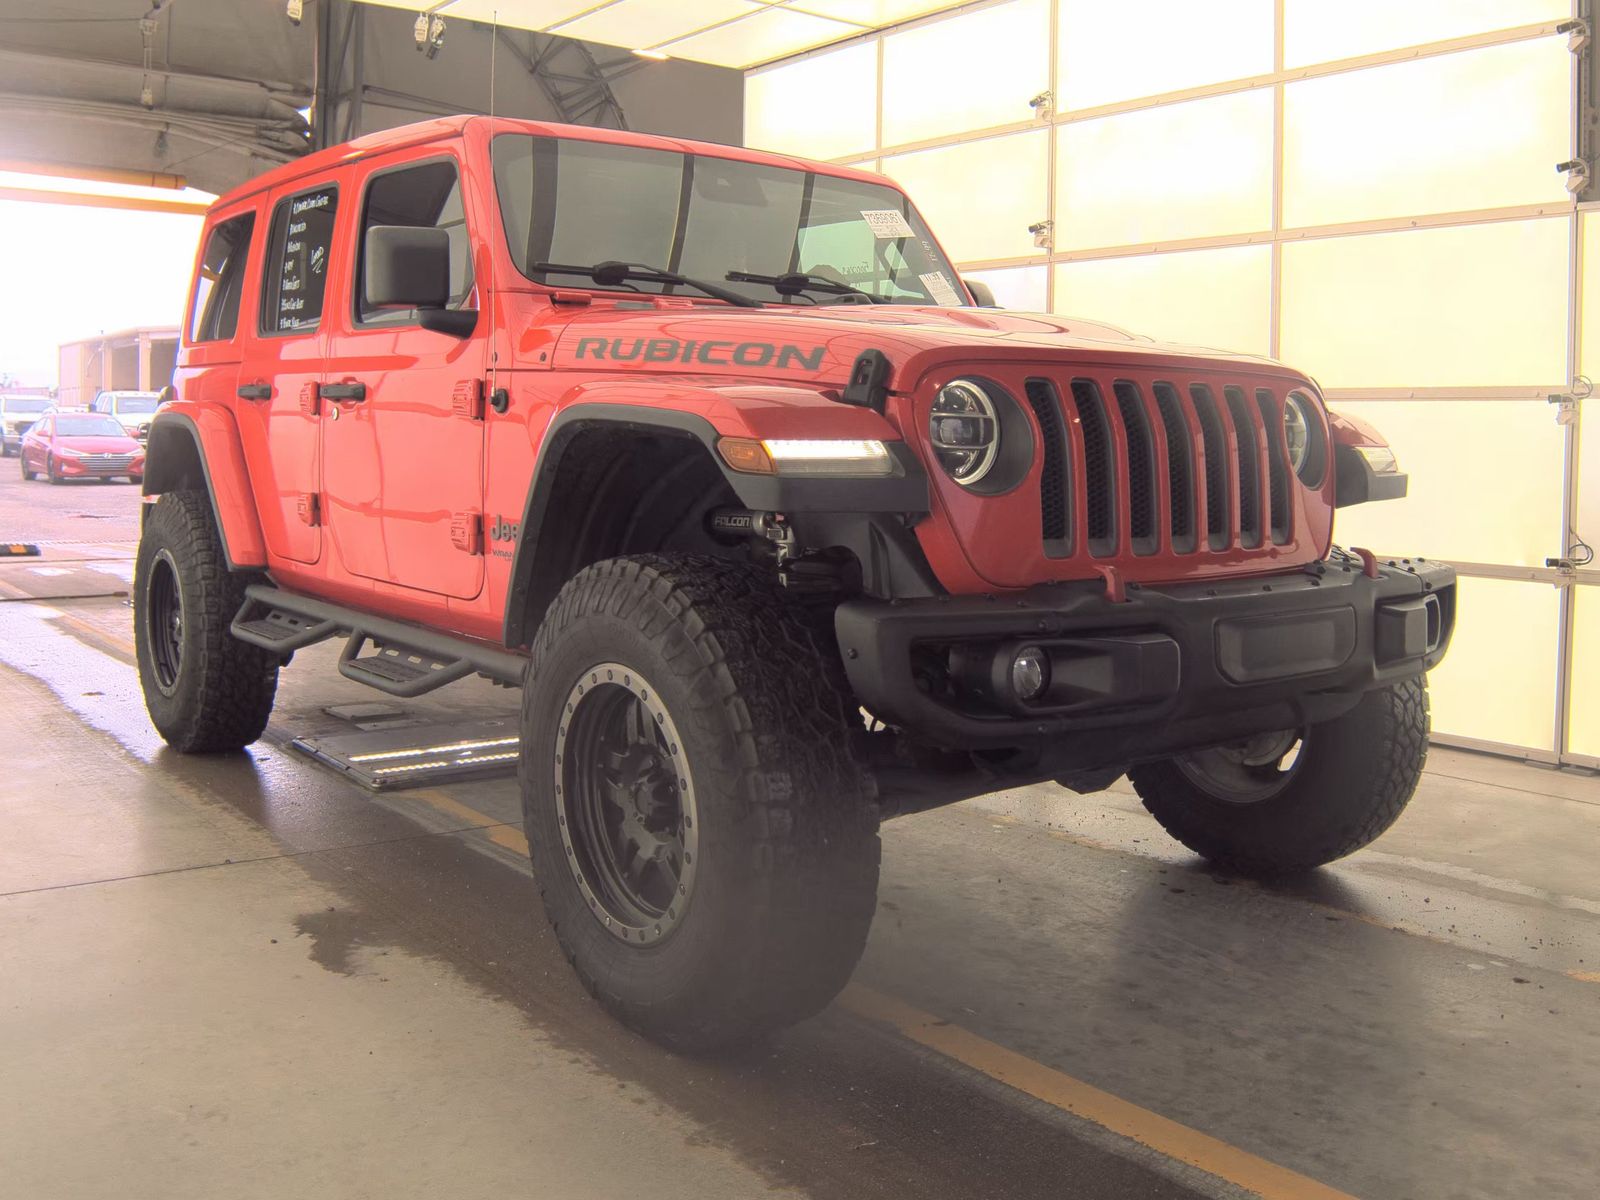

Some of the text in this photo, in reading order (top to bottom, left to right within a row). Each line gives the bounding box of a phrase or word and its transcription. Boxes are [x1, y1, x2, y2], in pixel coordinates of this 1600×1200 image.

[575, 337, 828, 371] RUBICON
[491, 514, 519, 542] Jee
[714, 516, 750, 527] FALCON
